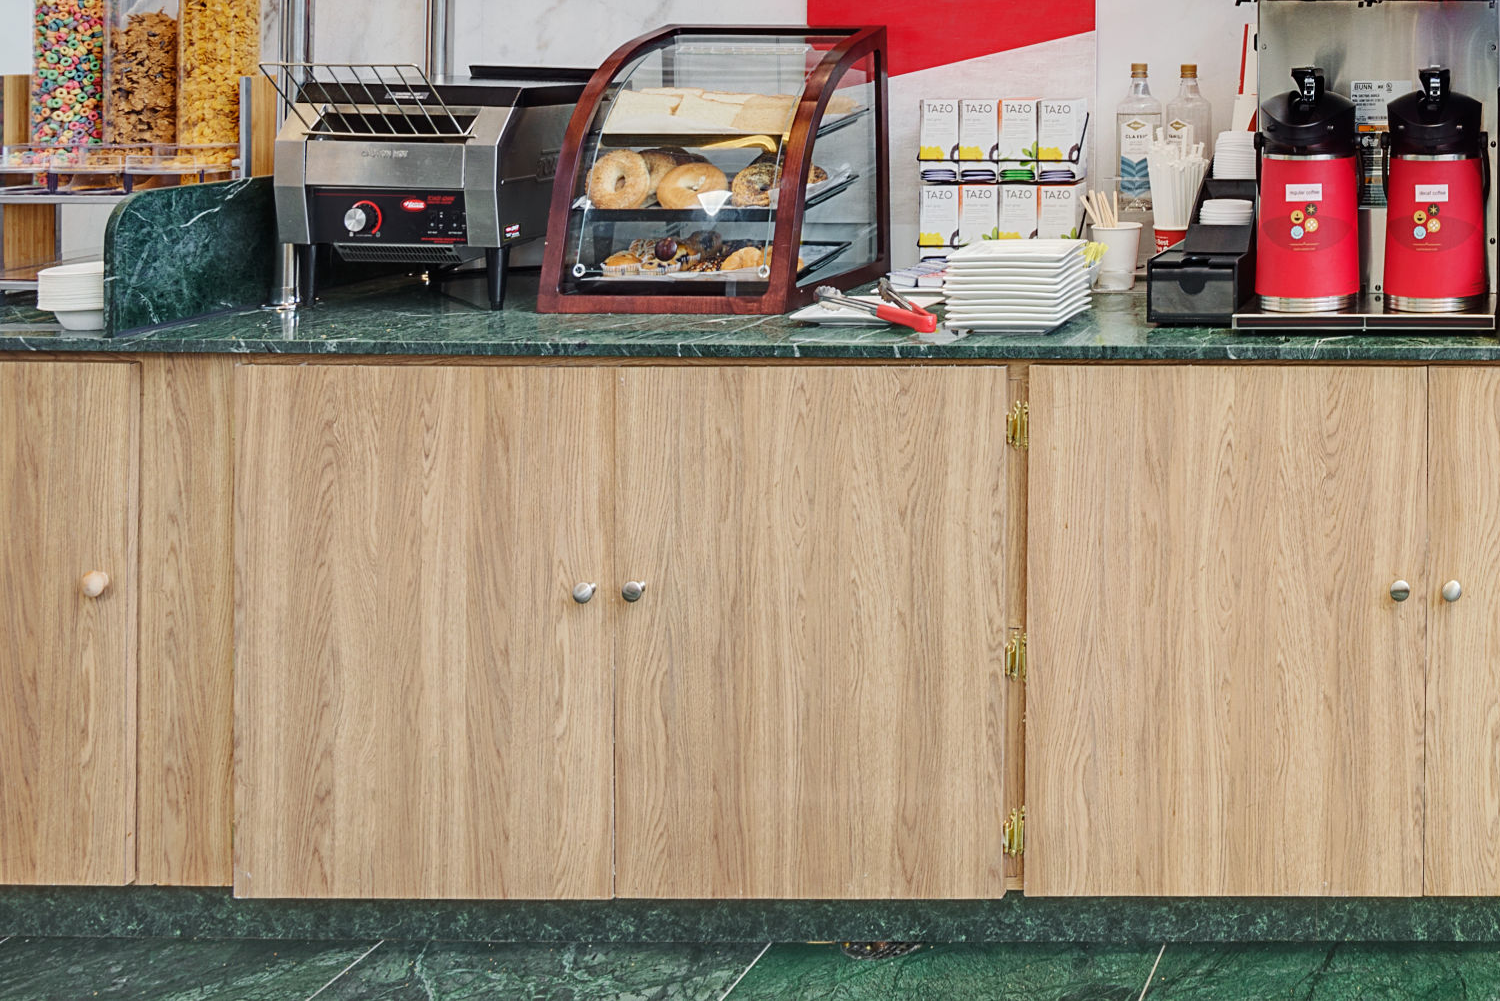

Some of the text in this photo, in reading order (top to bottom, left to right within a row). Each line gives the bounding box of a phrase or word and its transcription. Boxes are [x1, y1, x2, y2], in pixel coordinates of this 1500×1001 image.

[926, 104, 953, 113] TAZO
[966, 104, 992, 113] TAZO
[1005, 104, 1032, 113] TAZO
[1044, 104, 1071, 114] TAZO
[926, 190, 953, 200] TAZO
[966, 189, 992, 199] TAZO
[1005, 189, 1032, 199] TAZO
[1044, 190, 1071, 199] TAZO
